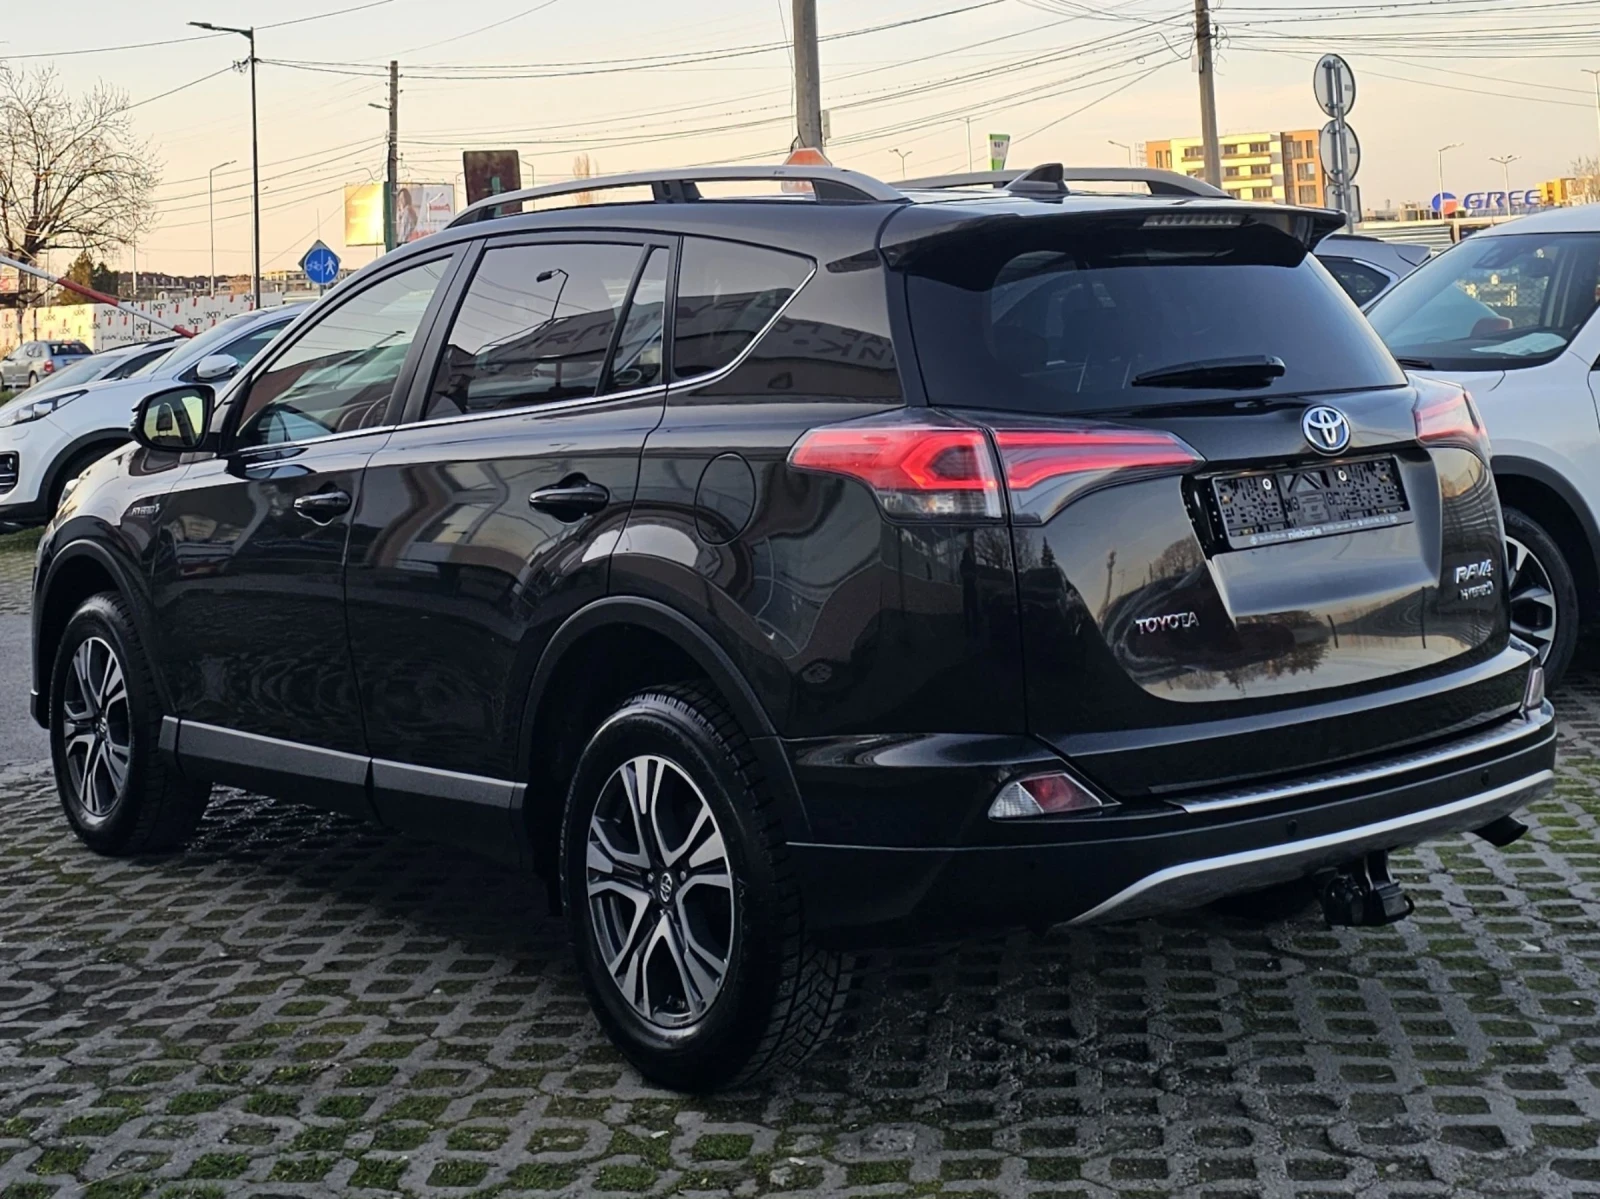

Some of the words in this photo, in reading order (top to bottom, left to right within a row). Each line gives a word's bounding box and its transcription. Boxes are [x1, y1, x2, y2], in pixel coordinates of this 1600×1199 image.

[1463, 190, 1541, 210] GREE
[1455, 558, 1494, 584] RAV4
[1135, 611, 1200, 635] TOYOTA
